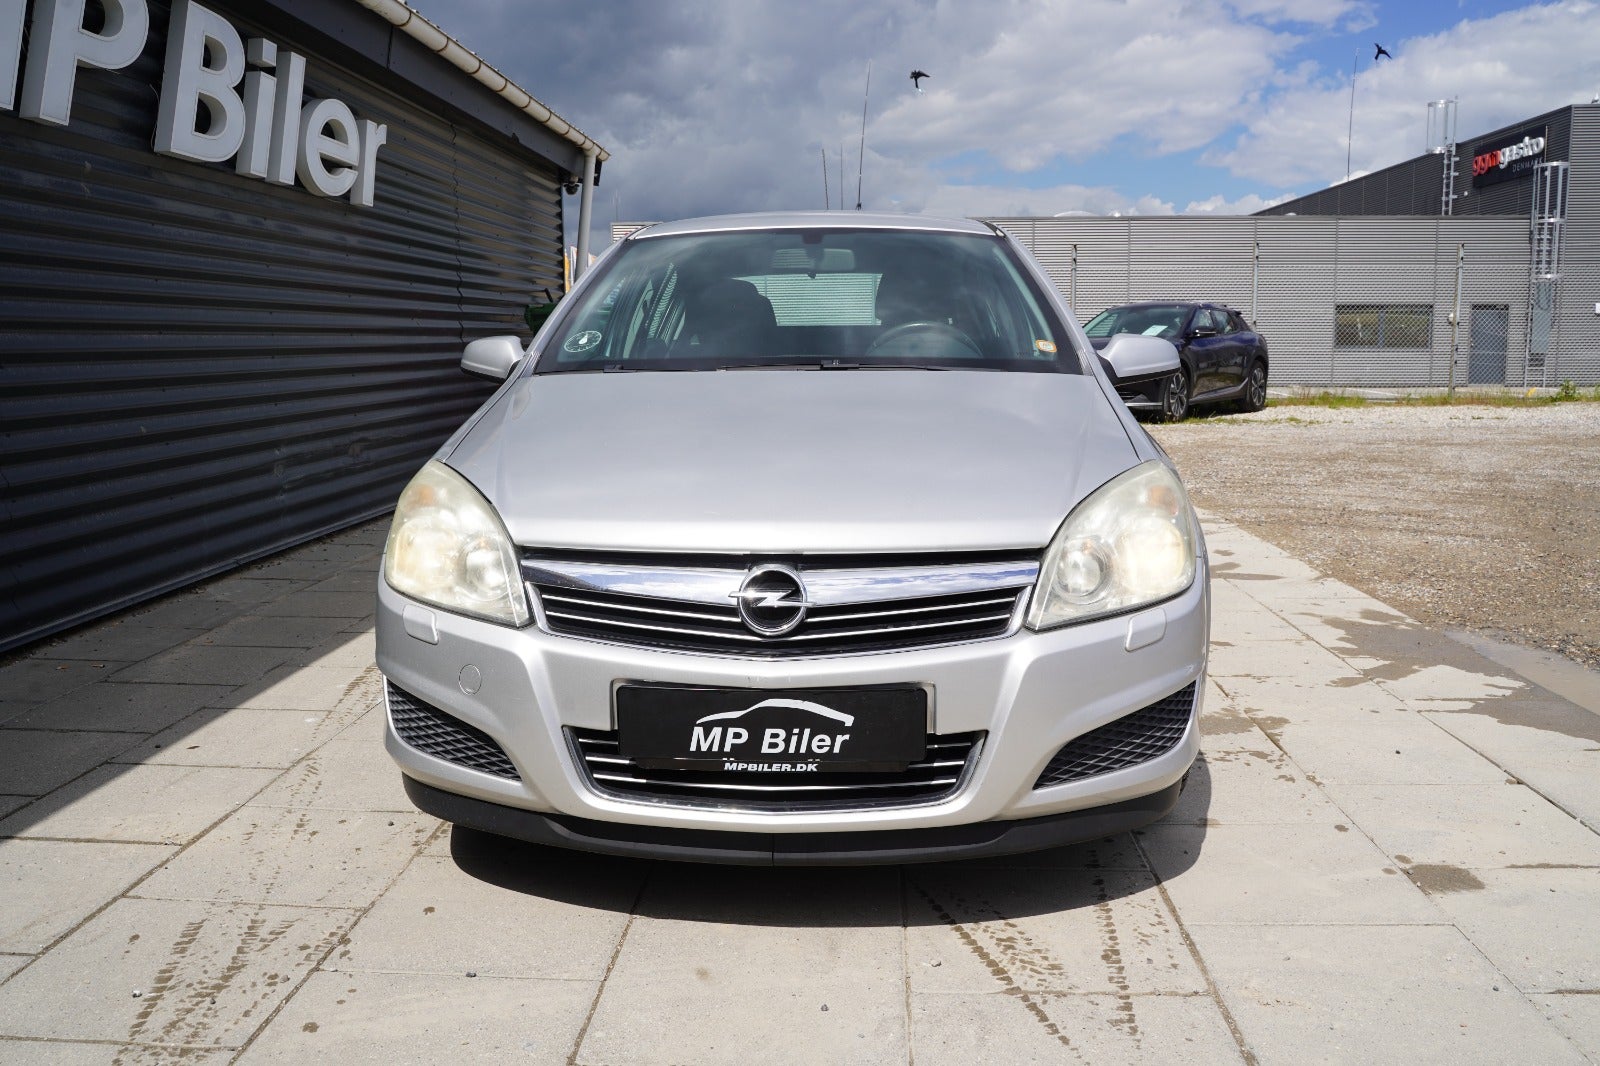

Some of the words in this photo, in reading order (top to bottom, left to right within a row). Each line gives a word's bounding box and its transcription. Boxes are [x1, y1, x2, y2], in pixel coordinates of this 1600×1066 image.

[0, 0, 149, 126] P
[154, 0, 387, 207] Biler
[689, 726, 749, 752] MP
[760, 728, 850, 754] Biler
[724, 762, 818, 772] MPBILER.DK
